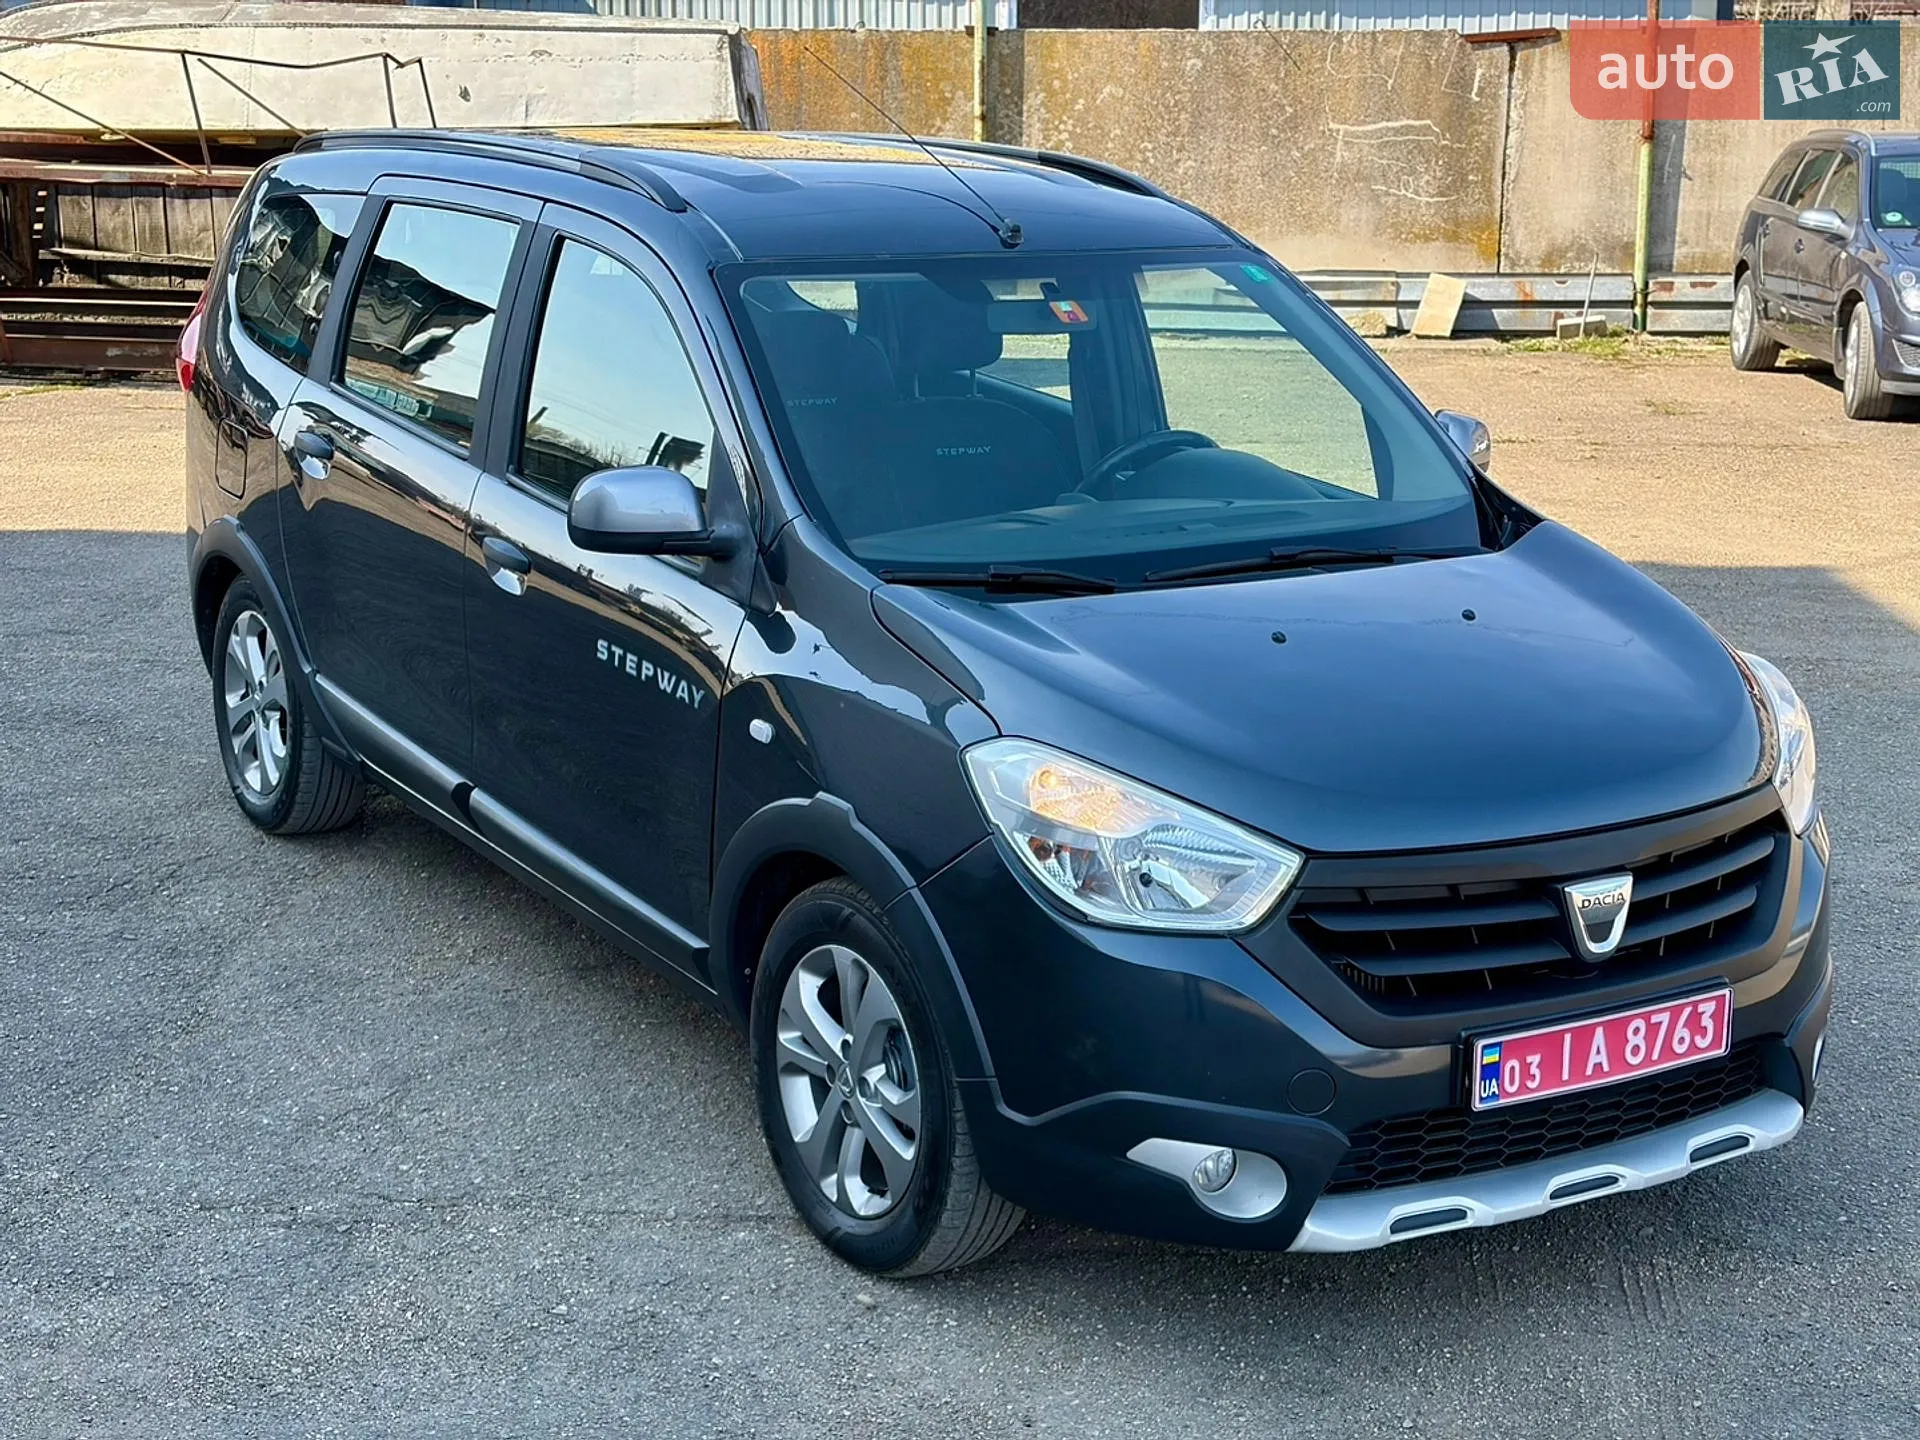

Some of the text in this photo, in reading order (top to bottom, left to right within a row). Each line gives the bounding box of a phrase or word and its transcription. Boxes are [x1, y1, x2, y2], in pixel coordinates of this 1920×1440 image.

[786, 397, 838, 407] STEPWAY
[936, 445, 992, 456] STEPWAY
[595, 638, 706, 710] STEPWAY
[1580, 892, 1627, 910] DACIA
[1503, 1053, 1542, 1093] 03
[1624, 1000, 1717, 1066] 8763
[1480, 1078, 1499, 1098] UA
